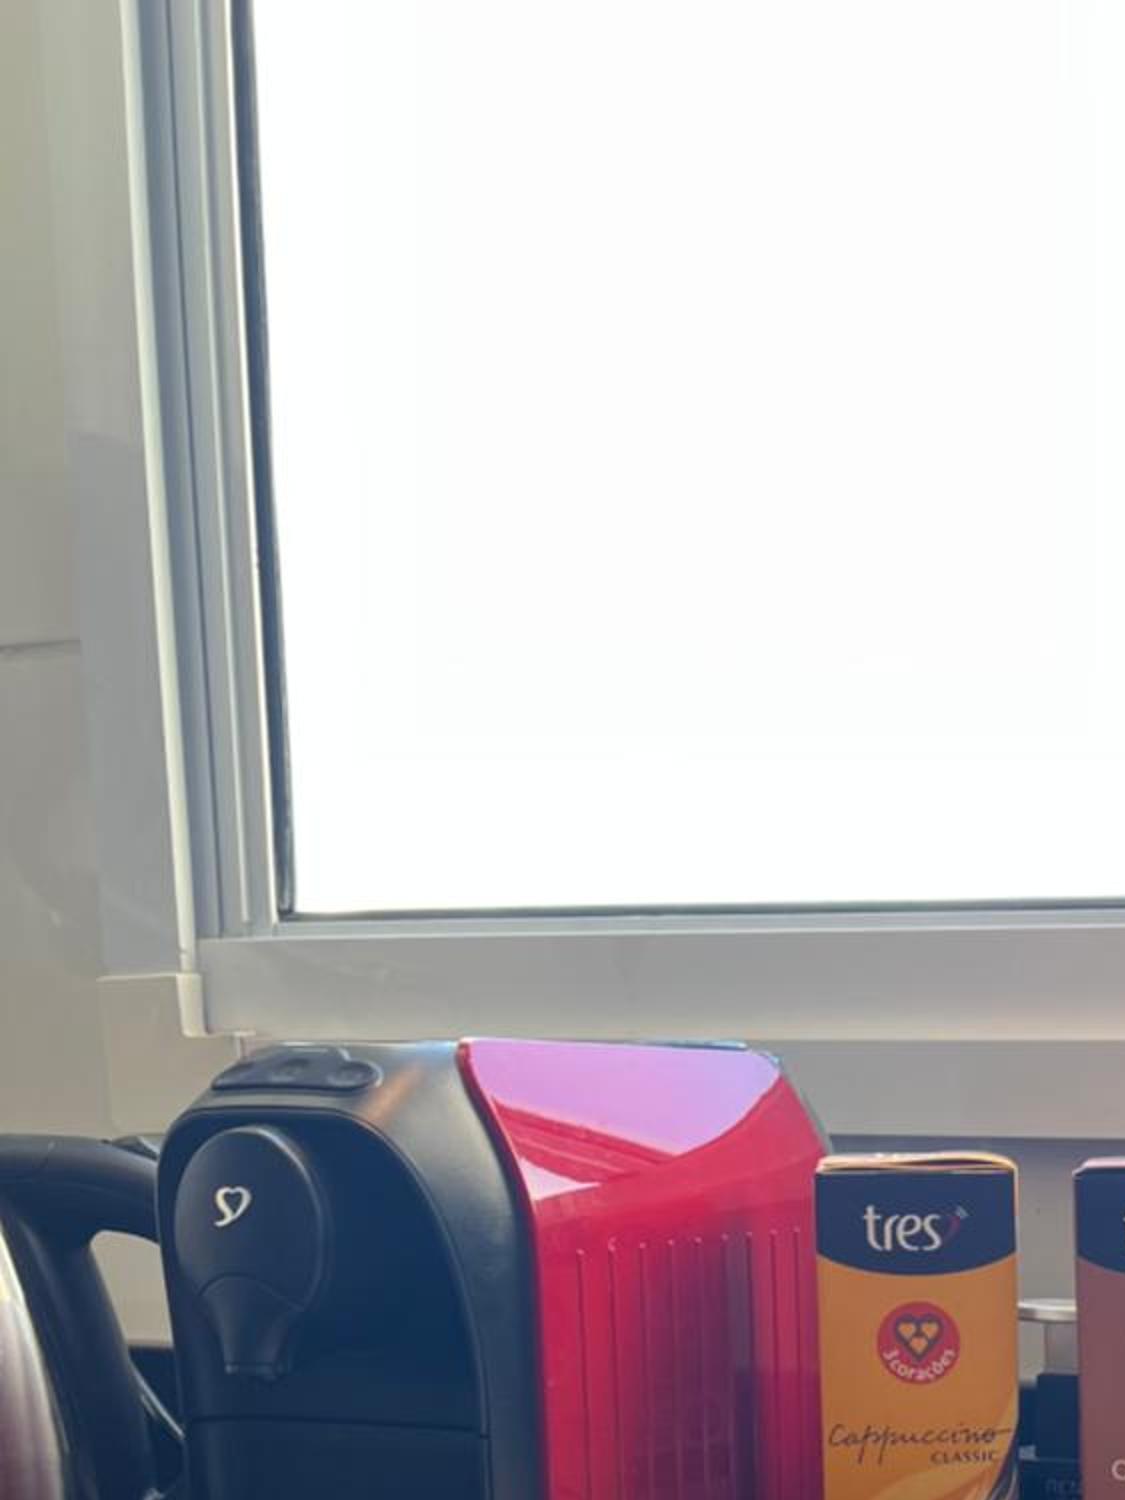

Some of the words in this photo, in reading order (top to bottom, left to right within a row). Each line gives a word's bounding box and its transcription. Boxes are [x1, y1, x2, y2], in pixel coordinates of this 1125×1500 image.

[863, 1204, 943, 1251] tres
[829, 1424, 1010, 1464] Cappuccino
[930, 1449, 999, 1464] CLASSIC
